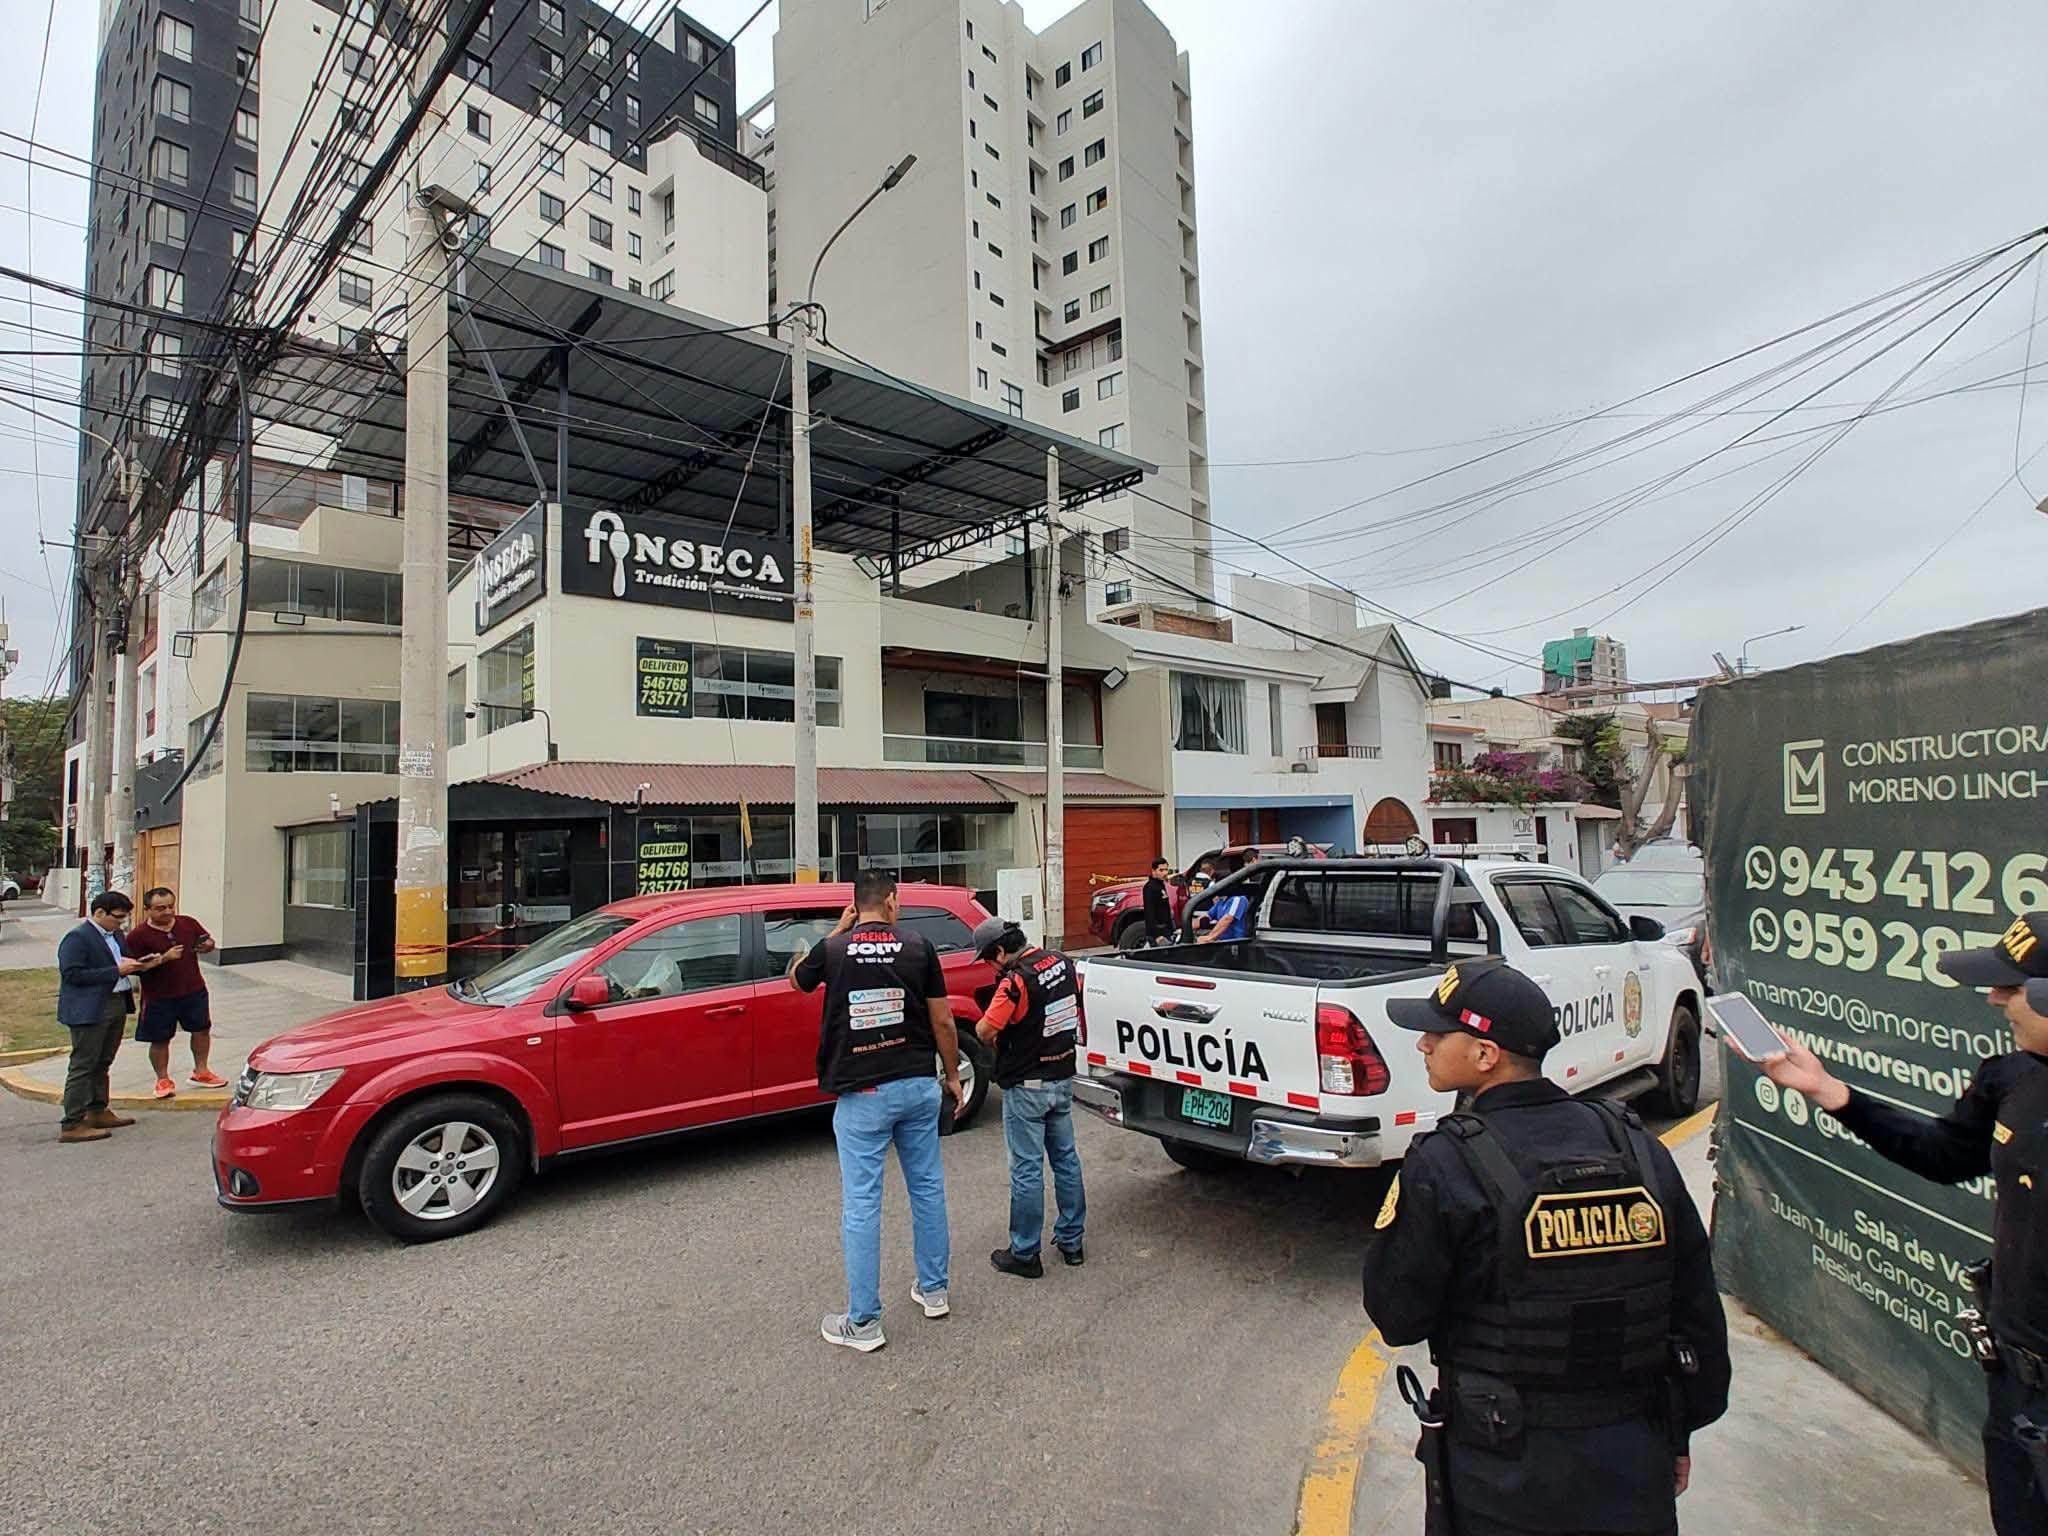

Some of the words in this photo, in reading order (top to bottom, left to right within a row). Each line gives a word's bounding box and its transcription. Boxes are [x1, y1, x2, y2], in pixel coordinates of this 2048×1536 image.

[634, 569, 708, 592] Tradición
[641, 659, 687, 673] DELIVERY!
[643, 675, 688, 692] 546768
[641, 689, 689, 707] 735771
[1849, 774, 1956, 803] MORENO
[642, 844, 686, 856] DELIVERY!
[638, 861, 690, 879] 546768
[1780, 846, 1877, 904] 943
[1883, 849, 1995, 915] 412
[852, 931, 897, 942] PRENSA
[1783, 908, 1878, 972] 959
[1748, 979, 2023, 1059] mam290@morenoli
[1116, 1019, 1270, 1082] POLICÍA
[1537, 1203, 1630, 1250] POLICIA
[1770, 1193, 1814, 1235] Juan
[1814, 1217, 1863, 1262] Julio
[1866, 1248, 1950, 1315] Ganoza
[1853, 1209, 1899, 1252] Sala
[1904, 1238, 1935, 1272] de
[1939, 1252, 1976, 1292] Ve
[1811, 1244, 1929, 1334] Residencial
